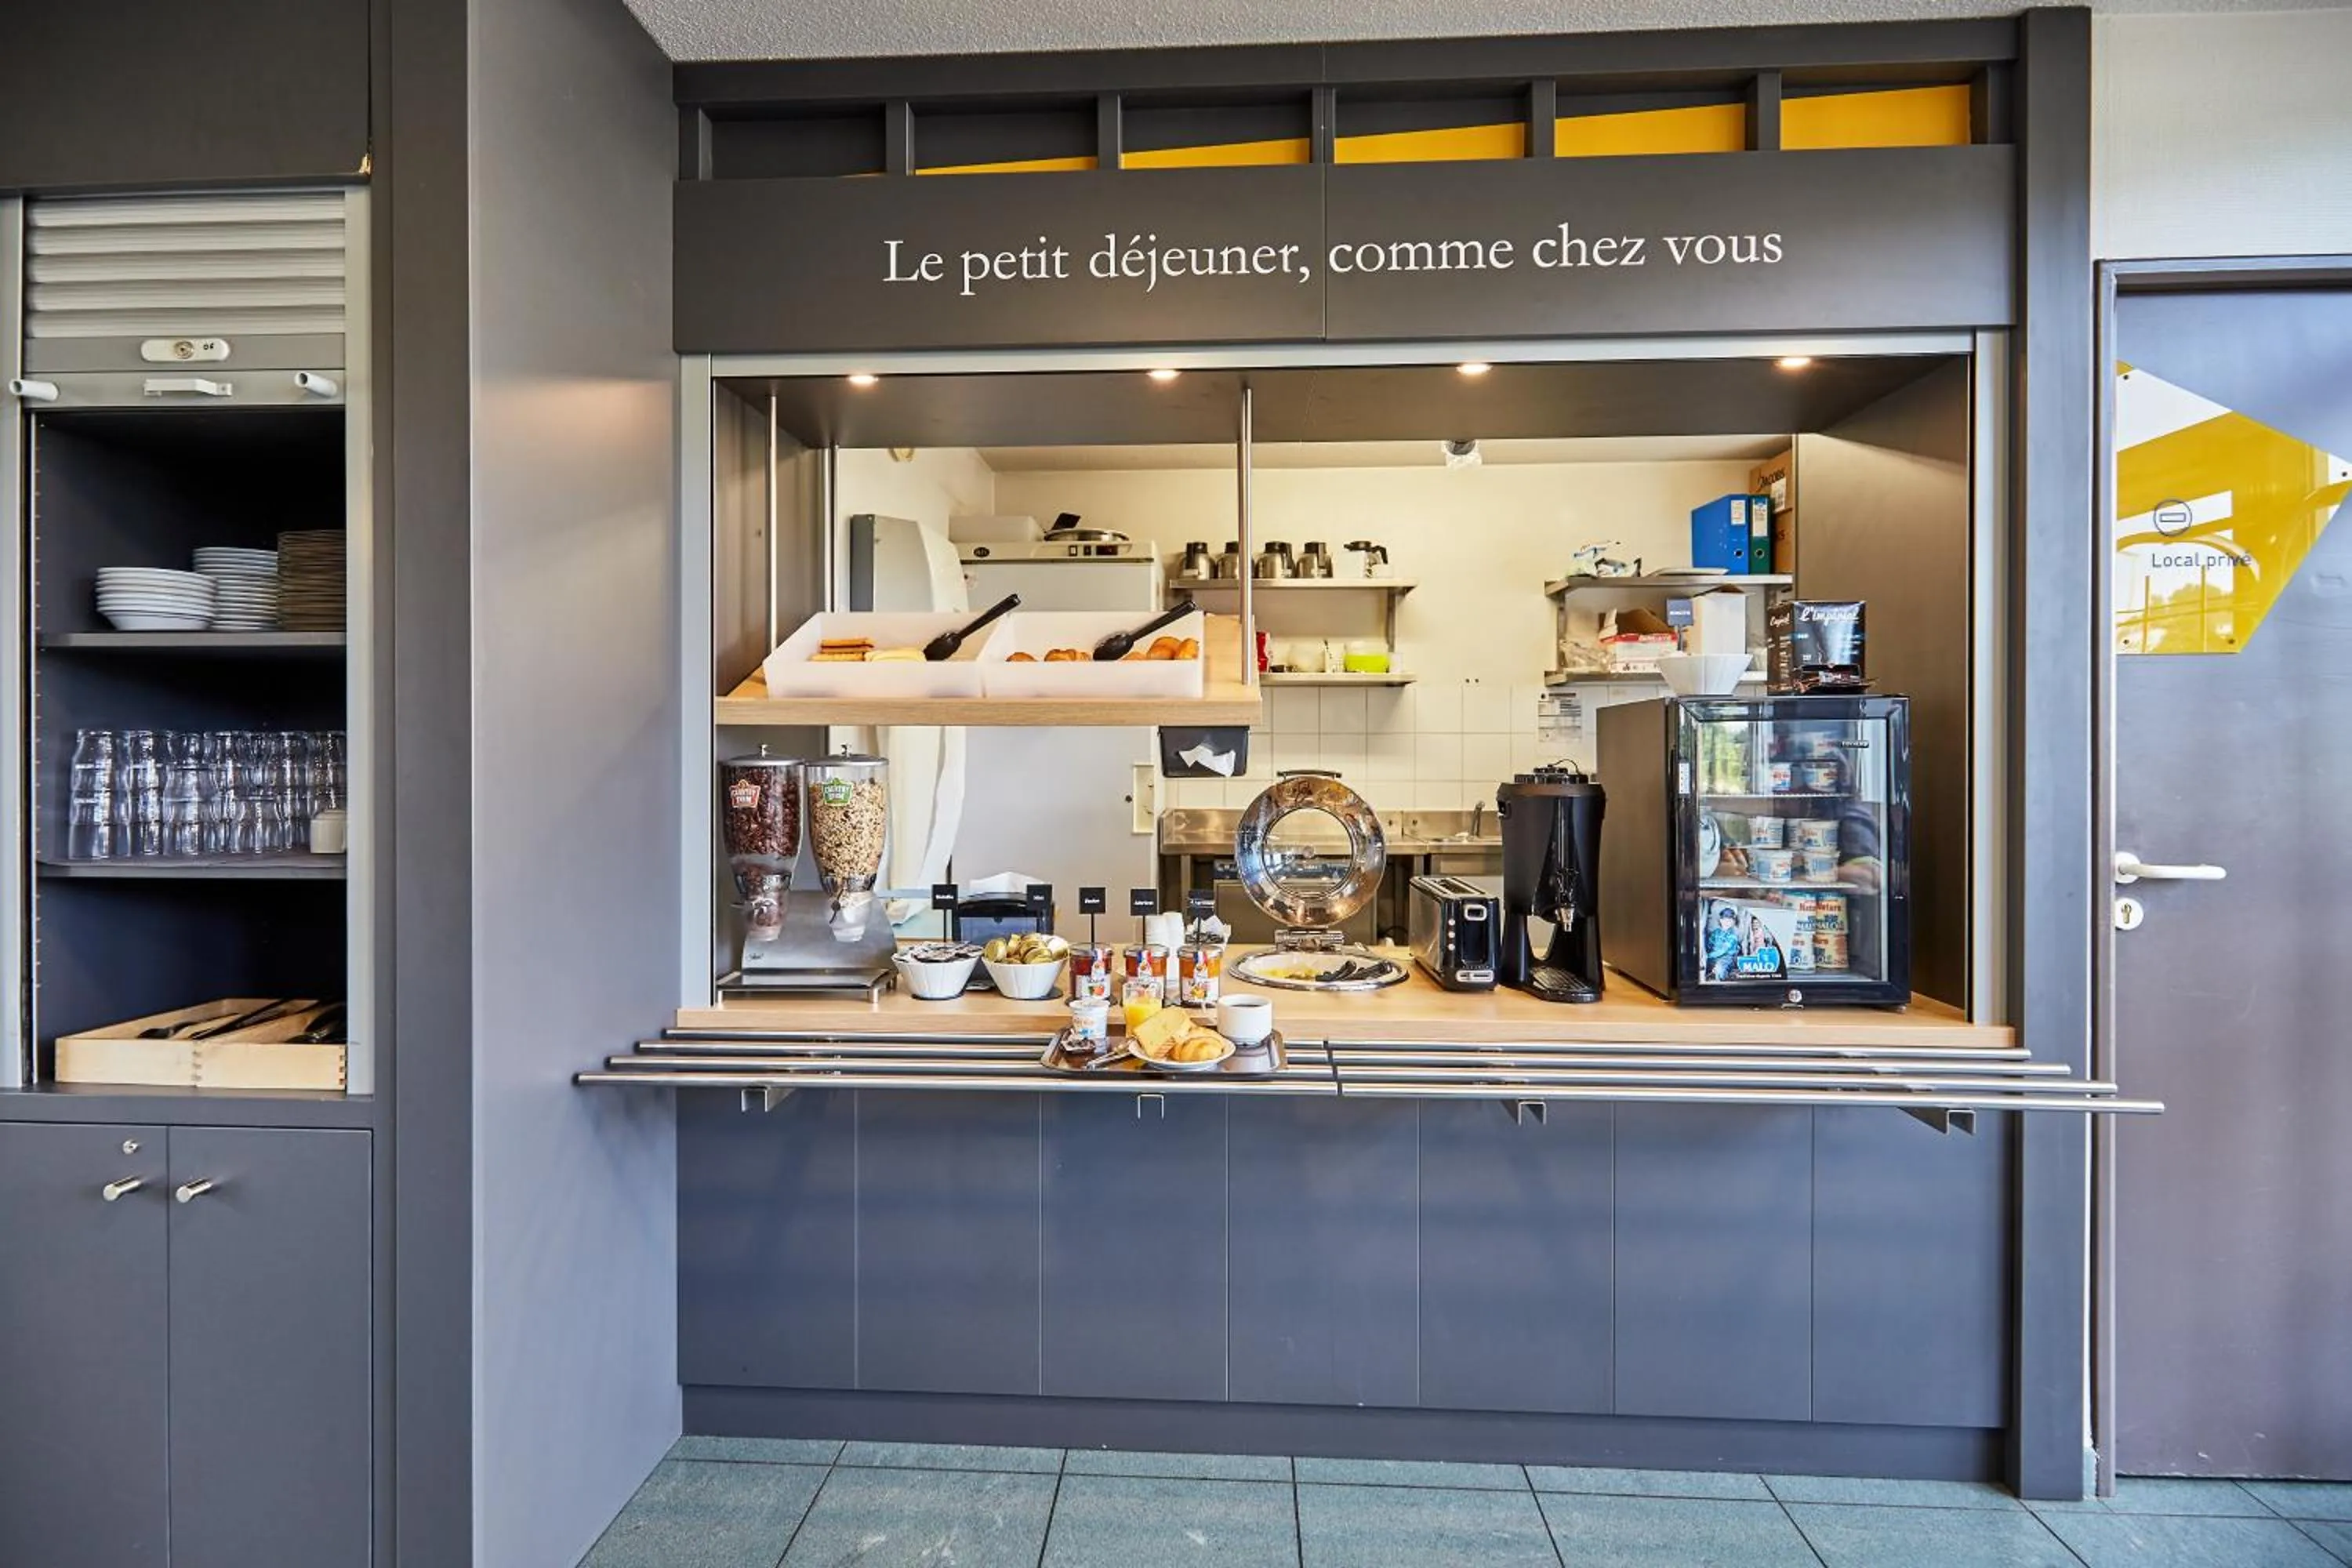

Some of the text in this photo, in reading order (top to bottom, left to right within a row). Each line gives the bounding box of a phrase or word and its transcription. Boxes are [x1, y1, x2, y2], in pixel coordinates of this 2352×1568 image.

[884, 222, 1784, 296] Le petit déjeuner, comme chez vous
[2151, 550, 2252, 570] Local privé
[1743, 961, 1776, 974] MALO
